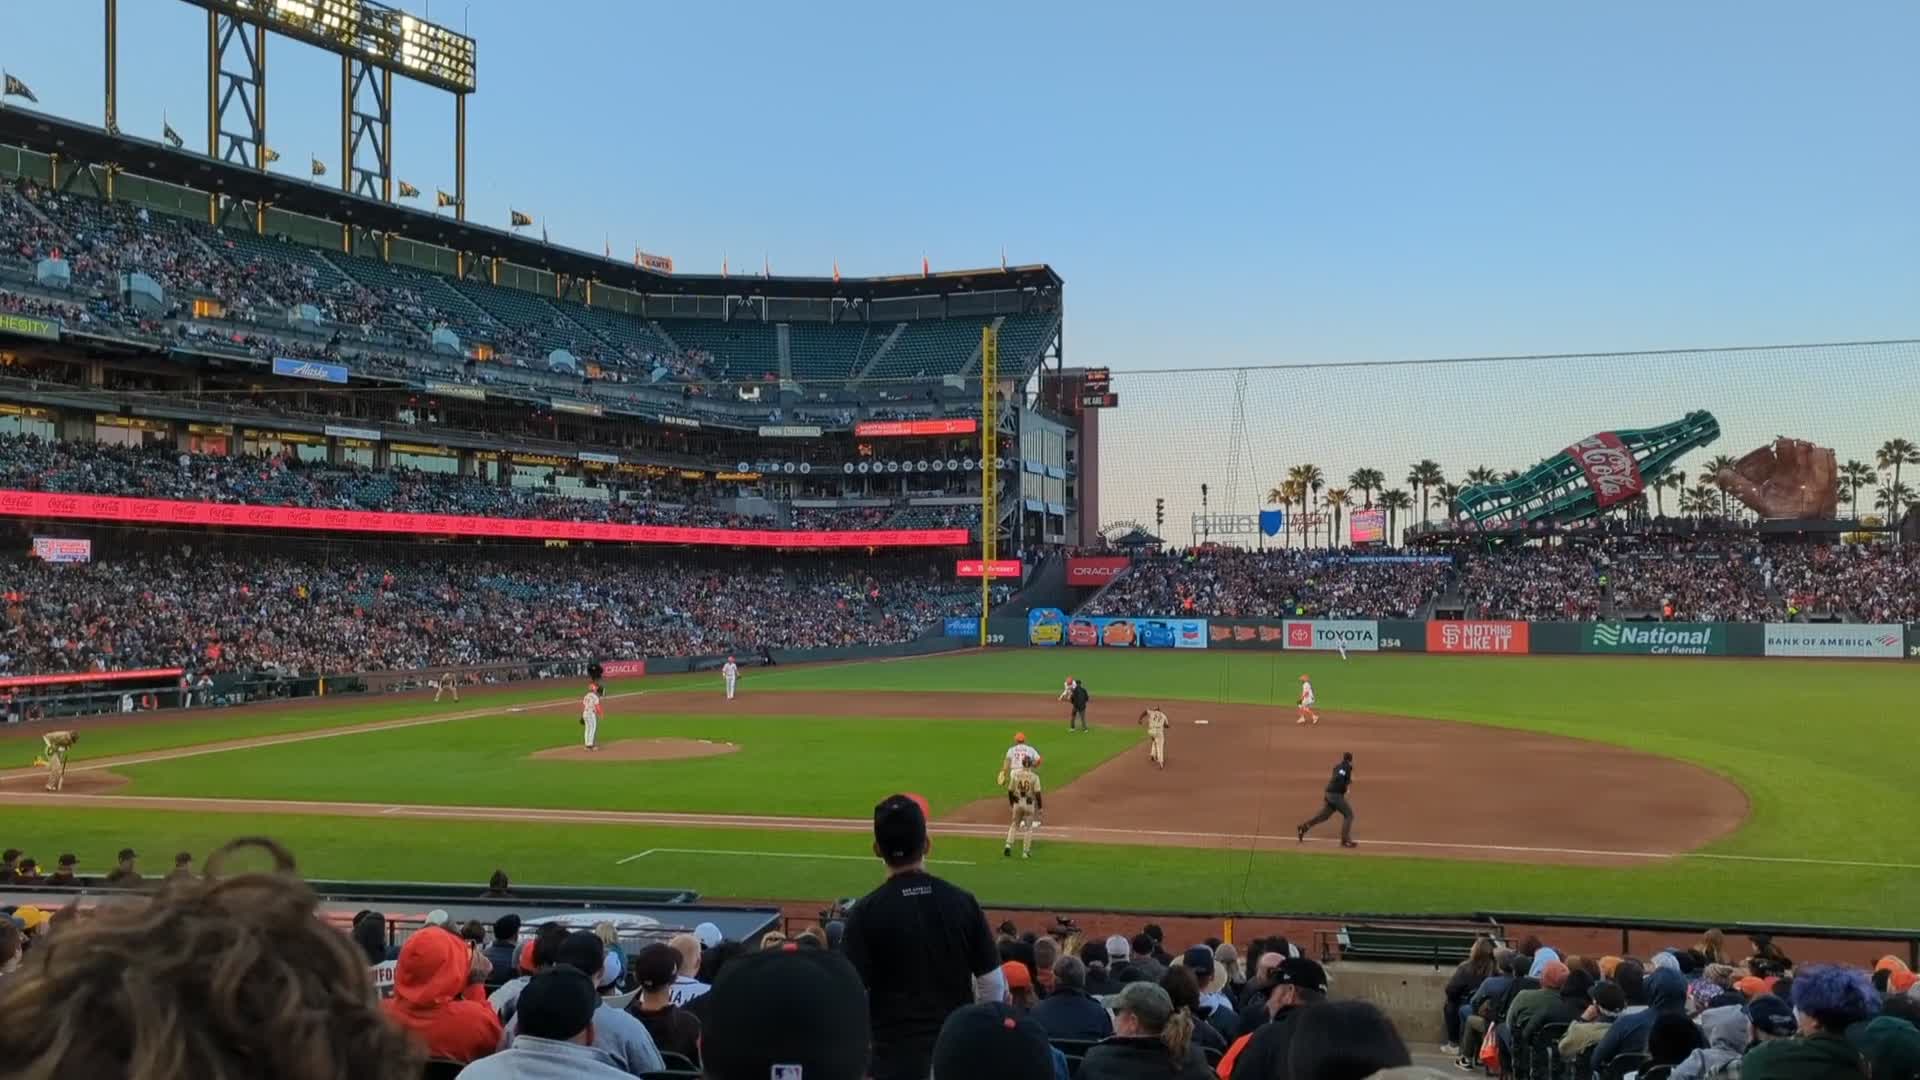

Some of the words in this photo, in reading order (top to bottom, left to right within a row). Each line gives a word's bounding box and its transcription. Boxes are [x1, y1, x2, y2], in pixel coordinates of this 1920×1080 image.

[1317, 630, 1373, 641] TOYOTA
[1464, 624, 1512, 638] NOTHING
[1620, 627, 1711, 645] National
[986, 634, 1005, 643] 339
[1380, 638, 1401, 648] 354
[1464, 637, 1491, 650] LIKE
[1496, 637, 1511, 650] IT
[1768, 637, 1800, 646] BANK
[1803, 638, 1817, 646] OF
[1819, 638, 1873, 647] AMERICA
[1650, 646, 1669, 655] Car
[1671, 645, 1707, 655] Rental
